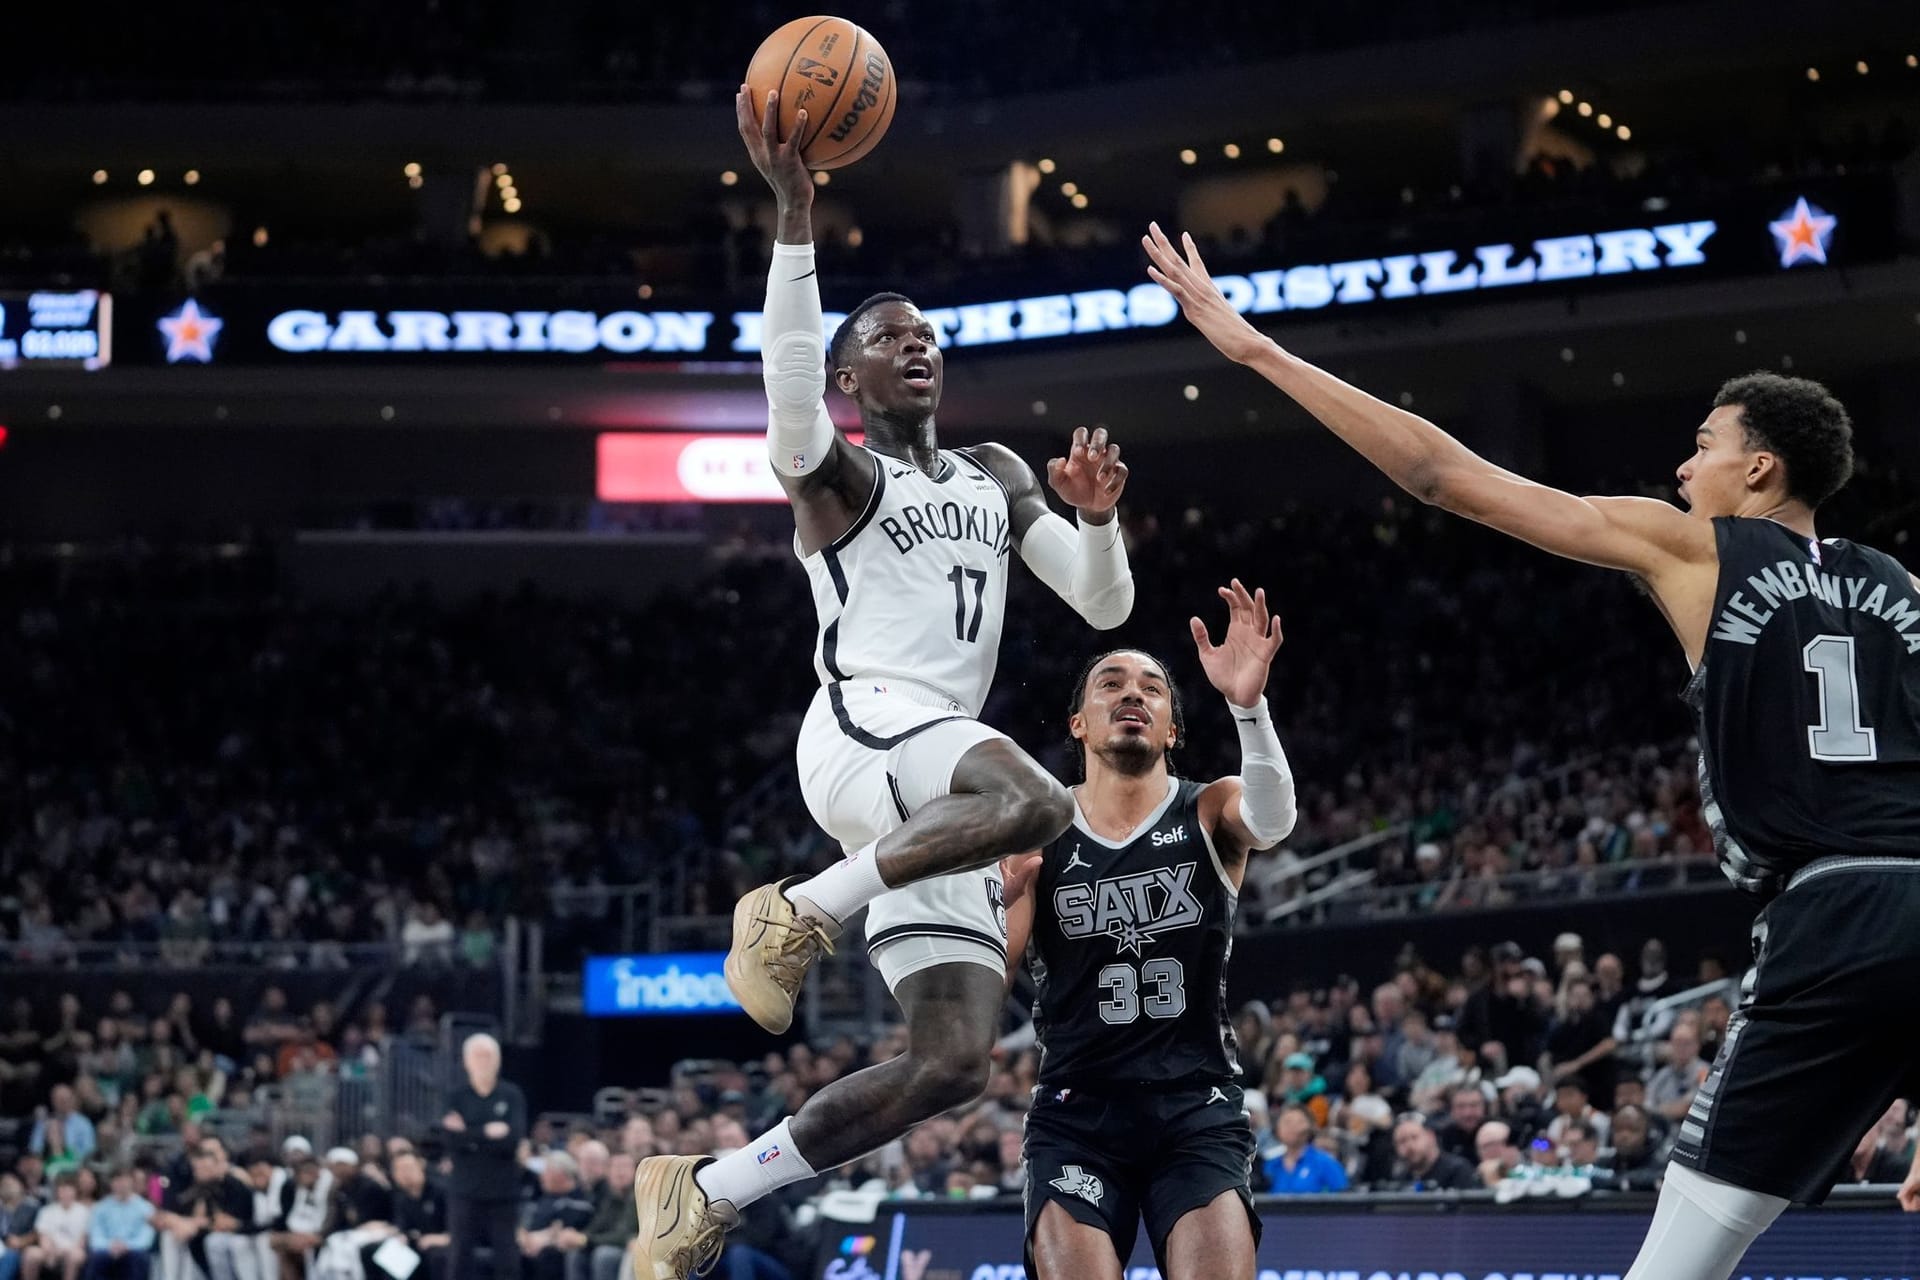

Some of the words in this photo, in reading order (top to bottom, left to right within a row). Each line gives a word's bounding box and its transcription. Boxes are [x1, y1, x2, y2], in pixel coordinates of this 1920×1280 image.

[267, 309, 713, 353] GARRISON
[732, 272, 1180, 353] THERS
[1209, 220, 1717, 314] DISTILLERY
[947, 565, 988, 643] 17
[1711, 560, 1920, 655] WEMBANYAMA
[1803, 634, 1878, 761] 1
[1151, 825, 1188, 847] Self.
[1053, 861, 1204, 941] SATX
[612, 957, 742, 1009] indee
[1098, 957, 1187, 1025] 33
